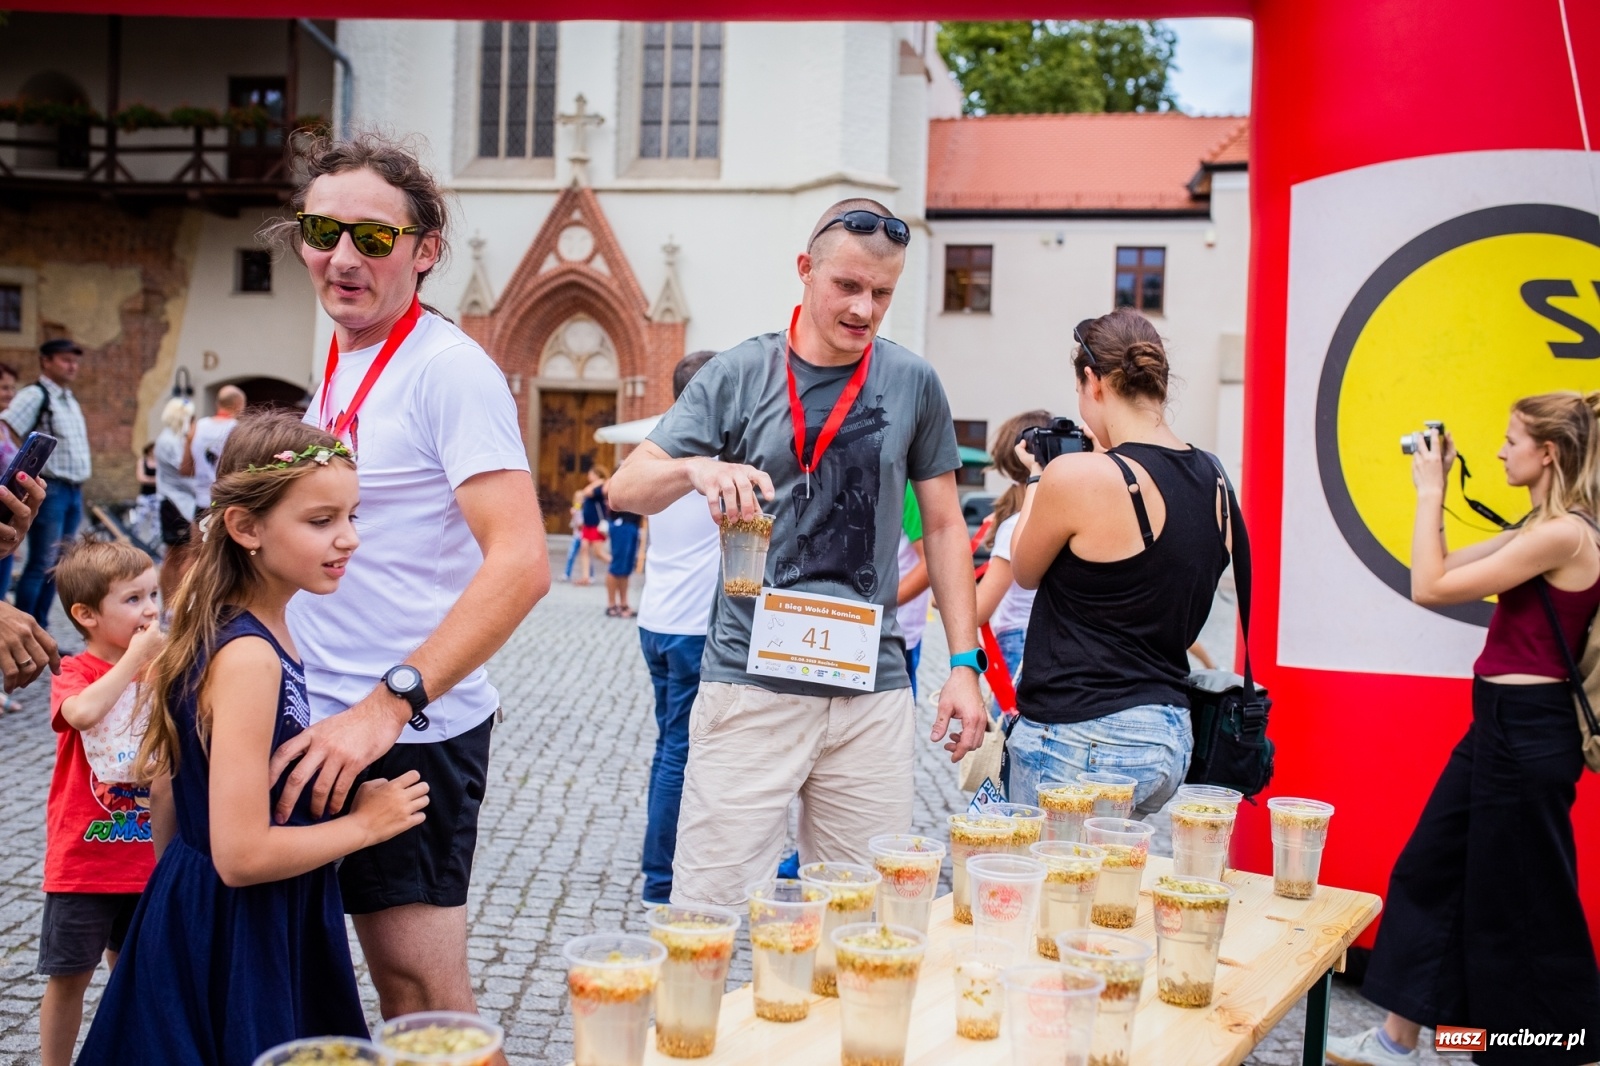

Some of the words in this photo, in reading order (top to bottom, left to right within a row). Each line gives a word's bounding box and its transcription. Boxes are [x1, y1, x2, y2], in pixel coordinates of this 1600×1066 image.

[1519, 279, 1600, 359] S
[784, 602, 802, 612] Bieg
[804, 605, 829, 615] Wokół
[831, 609, 861, 620] Komina
[801, 627, 831, 651] 41
[983, 780, 1006, 803] PRA
